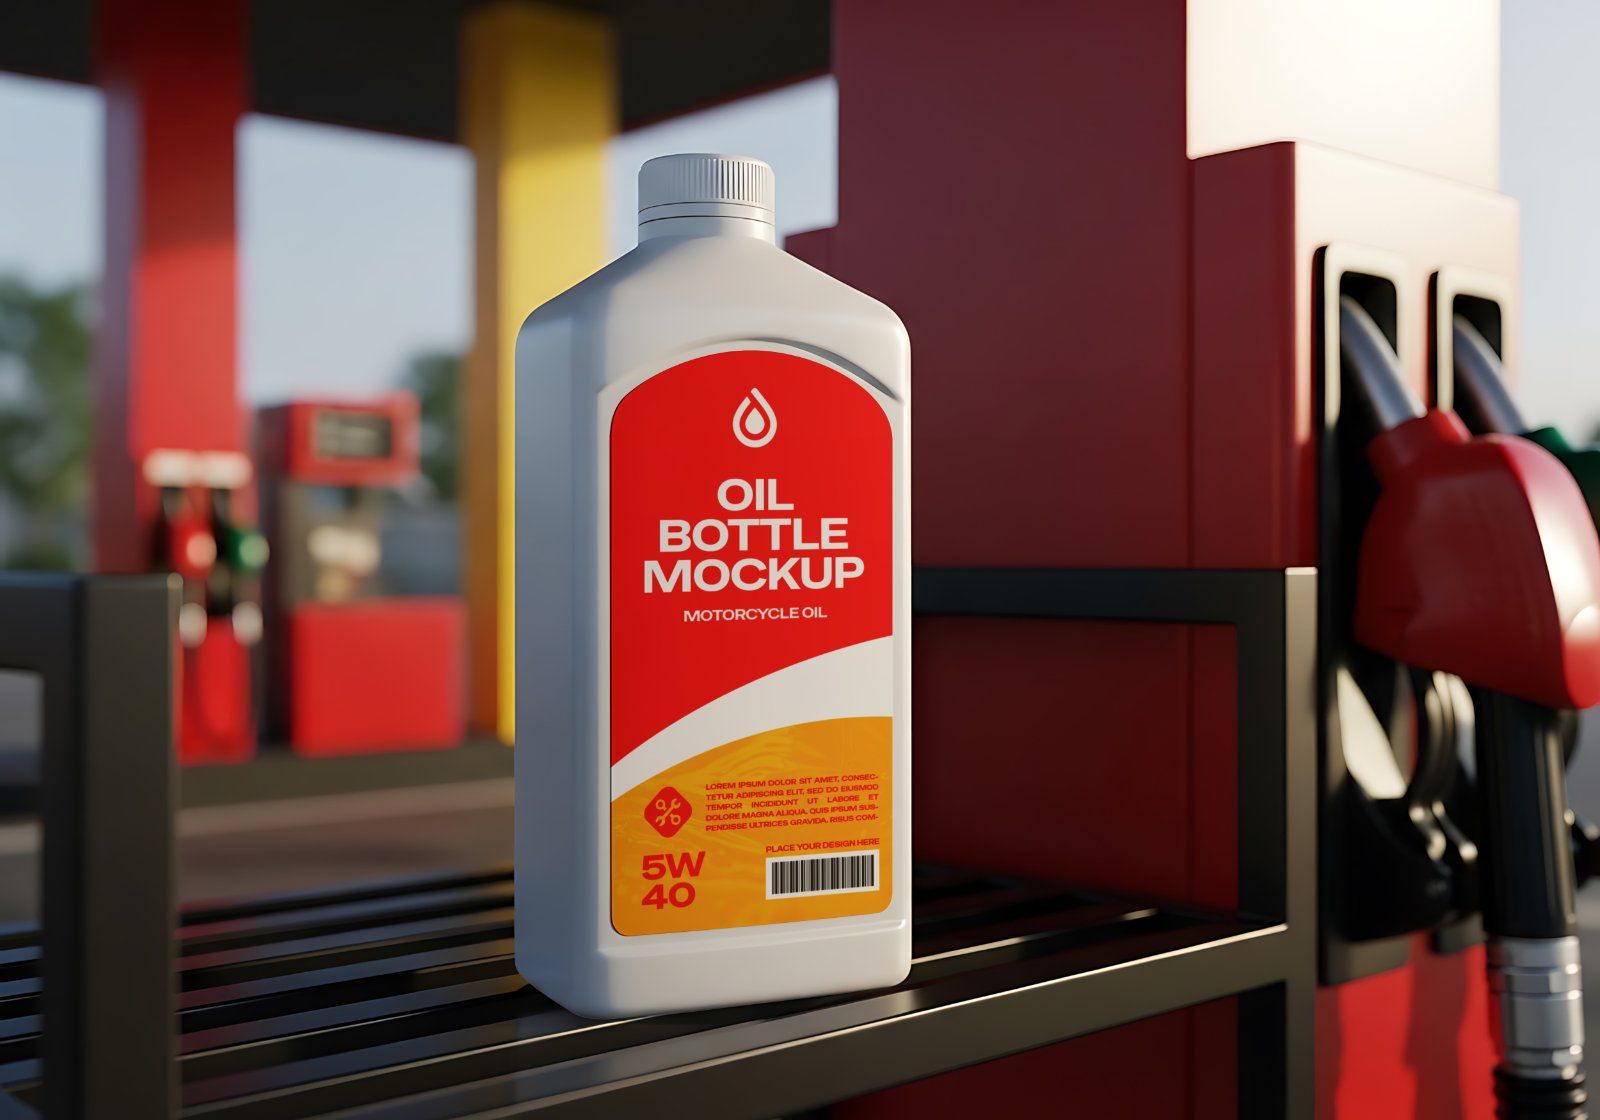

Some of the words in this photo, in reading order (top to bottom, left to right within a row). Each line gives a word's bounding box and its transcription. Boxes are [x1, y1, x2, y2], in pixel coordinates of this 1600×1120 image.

[717, 478, 794, 512] OIL
[659, 517, 849, 553] BOTTLE
[643, 556, 865, 594] MOCKUP
[683, 607, 800, 622] MOTORCYCLE
[802, 606, 828, 619] OIL
[706, 782, 736, 790] LOREM
[738, 780, 766, 788] IPSUM
[768, 778, 797, 786] DOLOR
[842, 774, 879, 782] CONSEC-
[706, 793, 734, 801] TETUR
[736, 790, 784, 799] ADIPISCING
[786, 788, 805, 796] ELIT,
[841, 784, 879, 792] EIUSMOD
[706, 802, 743, 811] TEMPOR
[752, 798, 798, 808] INCIDIDUNT
[827, 794, 860, 803] LABORE
[706, 813, 740, 822] DOLORE
[742, 810, 774, 819] MAGNA
[776, 808, 808, 816] ALIQUA.
[810, 806, 830, 814] QUIS
[706, 822, 748, 832] PENDISSE
[749, 820, 788, 829] ULTRICES
[766, 844, 796, 853] PLACE
[797, 842, 820, 850] YOUR
[822, 840, 856, 848] DESIGN
[857, 838, 880, 846] HERE
[642, 851, 706, 881] 5W
[641, 882, 696, 910] 40
